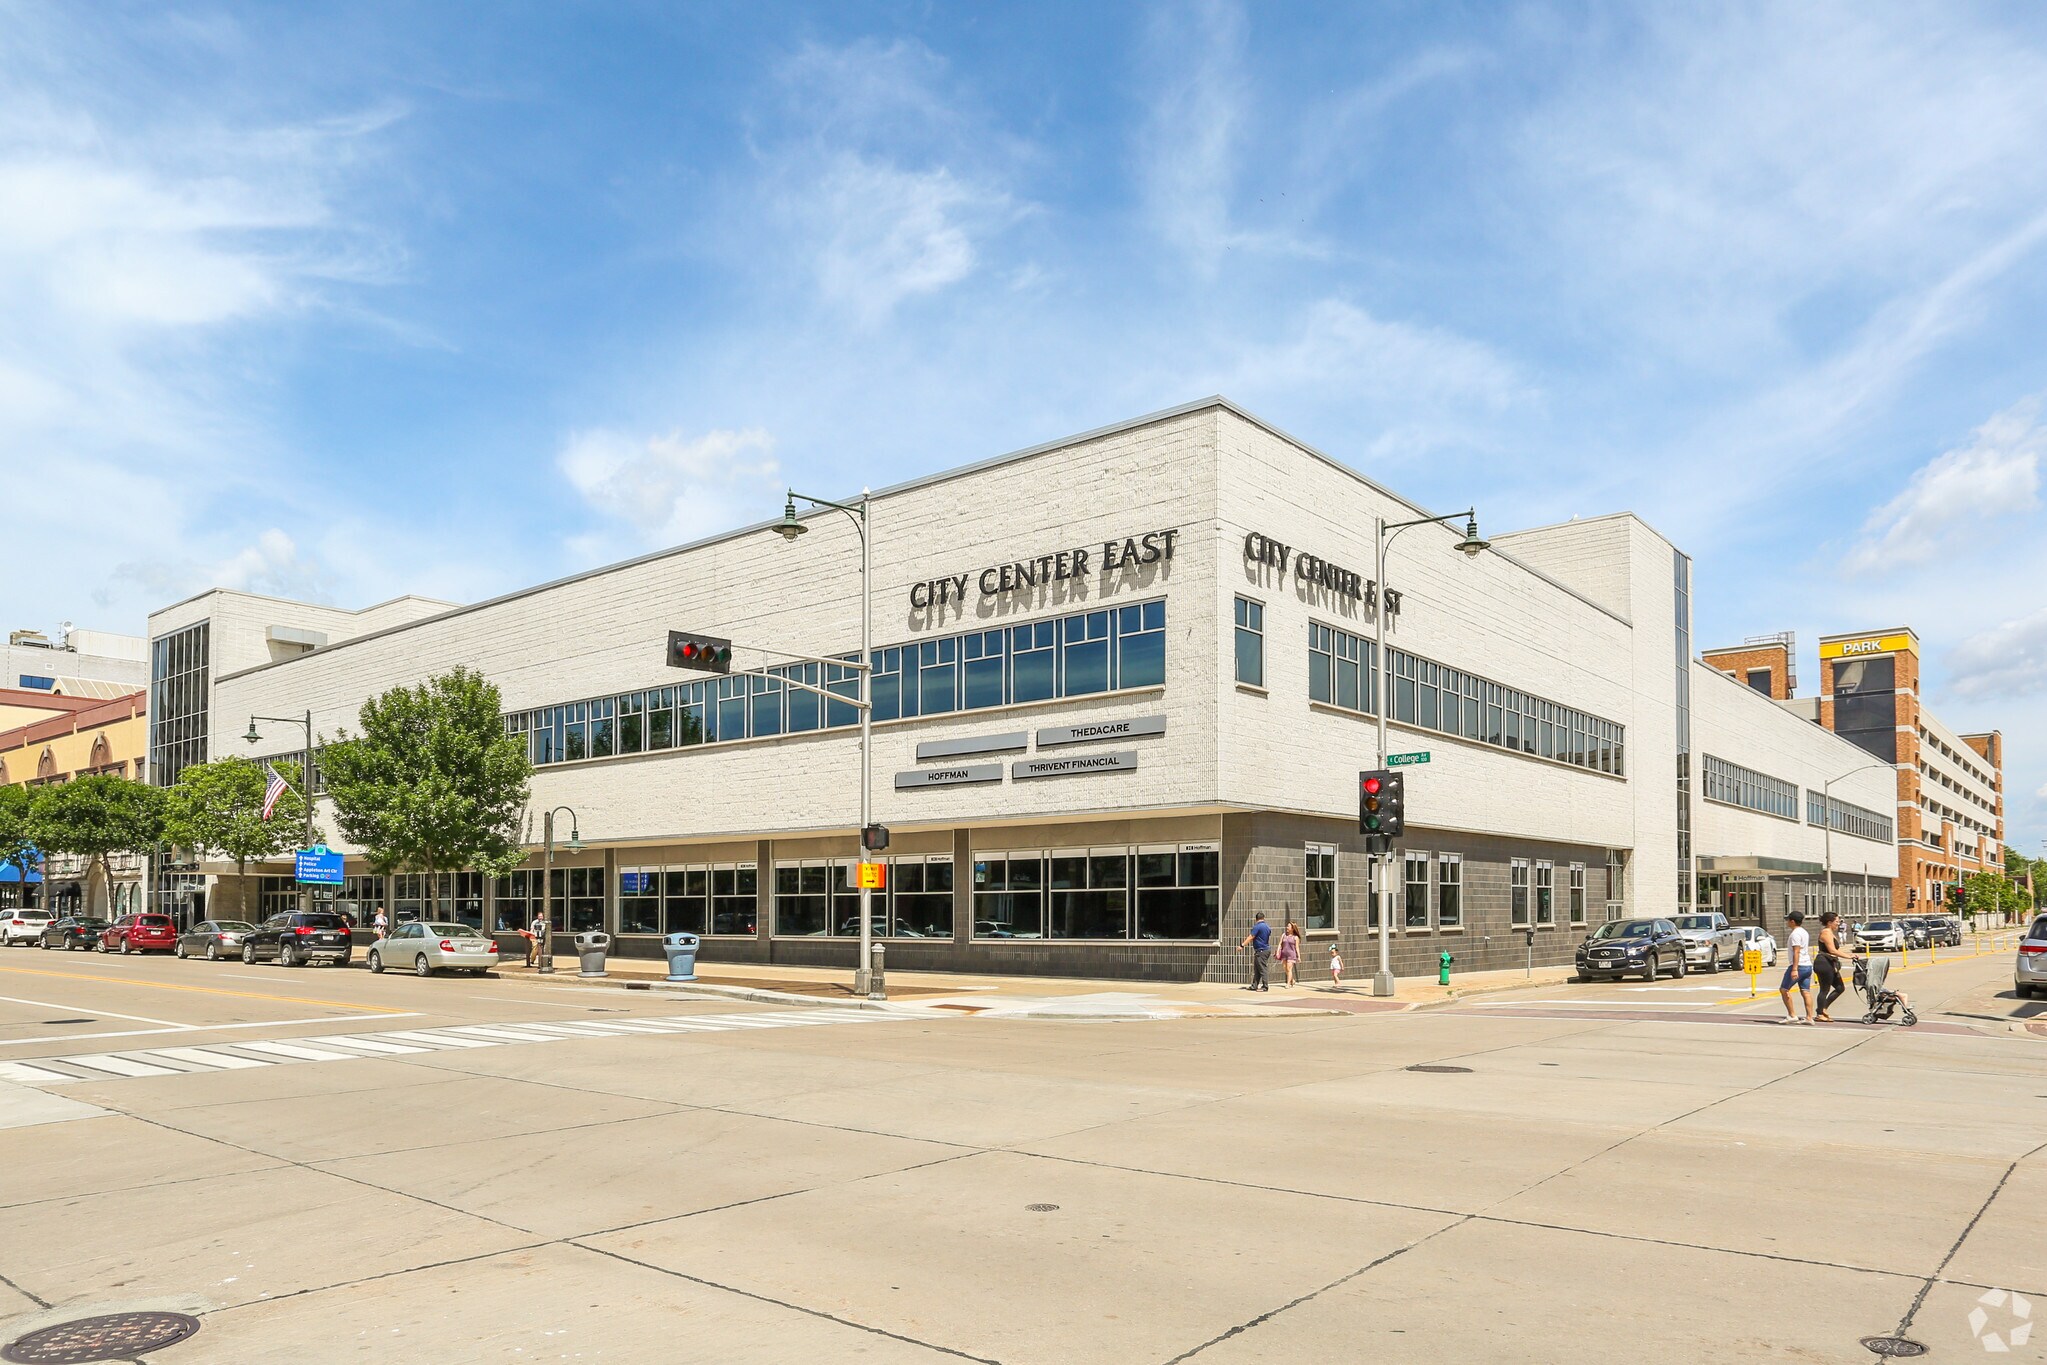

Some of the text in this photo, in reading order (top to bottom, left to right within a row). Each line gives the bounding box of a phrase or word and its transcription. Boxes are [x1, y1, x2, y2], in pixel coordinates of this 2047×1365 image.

[910, 529, 1178, 608] CITY CENTER EAST
[1245, 532, 1403, 615] CITY CENTER EST
[1843, 640, 1881, 654] PARK
[1071, 723, 1130, 738] THEDACARE
[1029, 757, 1119, 773] THRIVENT FINANCIAL
[1394, 755, 1420, 764] College
[928, 770, 968, 781] HOFFMAN
